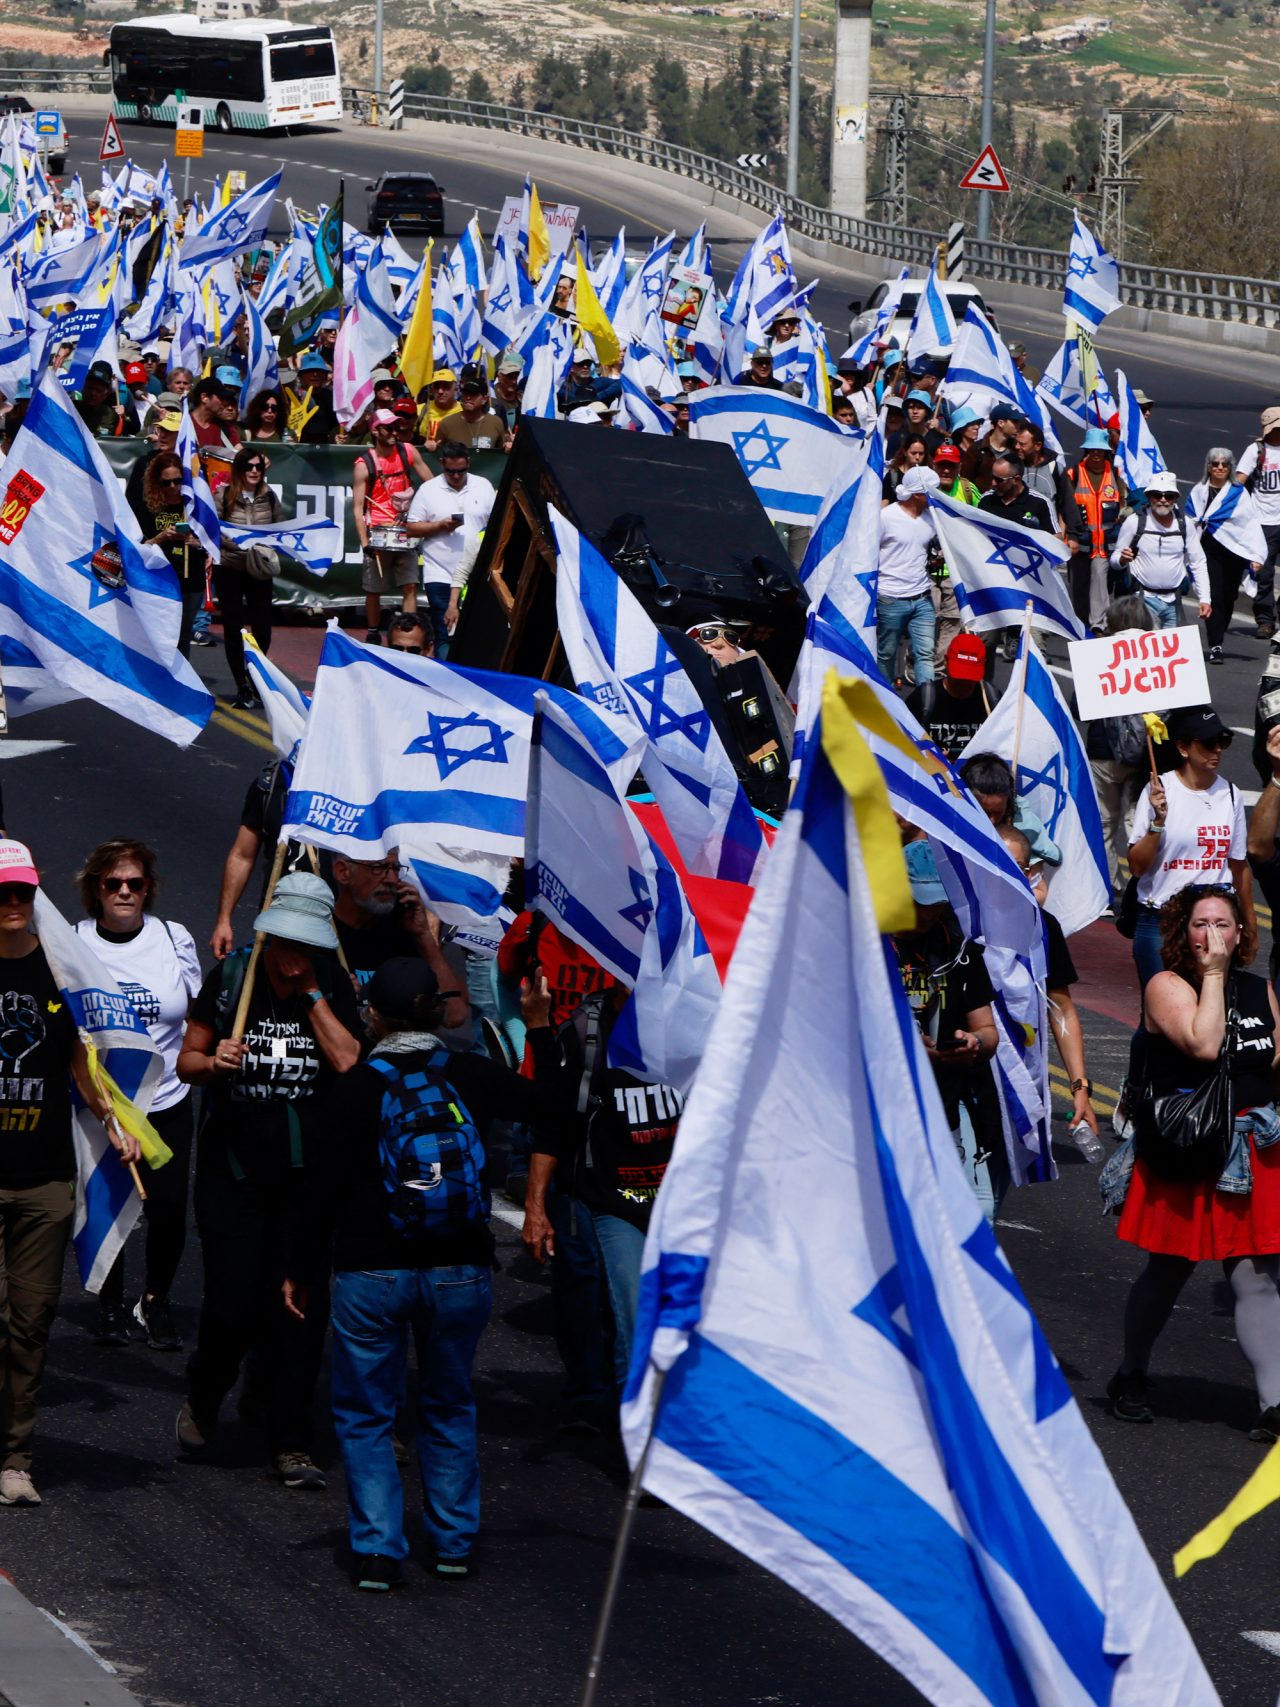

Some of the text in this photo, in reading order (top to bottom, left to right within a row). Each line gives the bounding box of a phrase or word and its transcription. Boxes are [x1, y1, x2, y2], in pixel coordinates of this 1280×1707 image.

[16, 474, 42, 499] BRING
[1107, 632, 1179, 669] עולות
[1098, 658, 1190, 696] להגנה
[1197, 826, 1230, 837] קודם
[1198, 837, 1231, 859] כל
[258, 1018, 300, 1039] ואין לך
